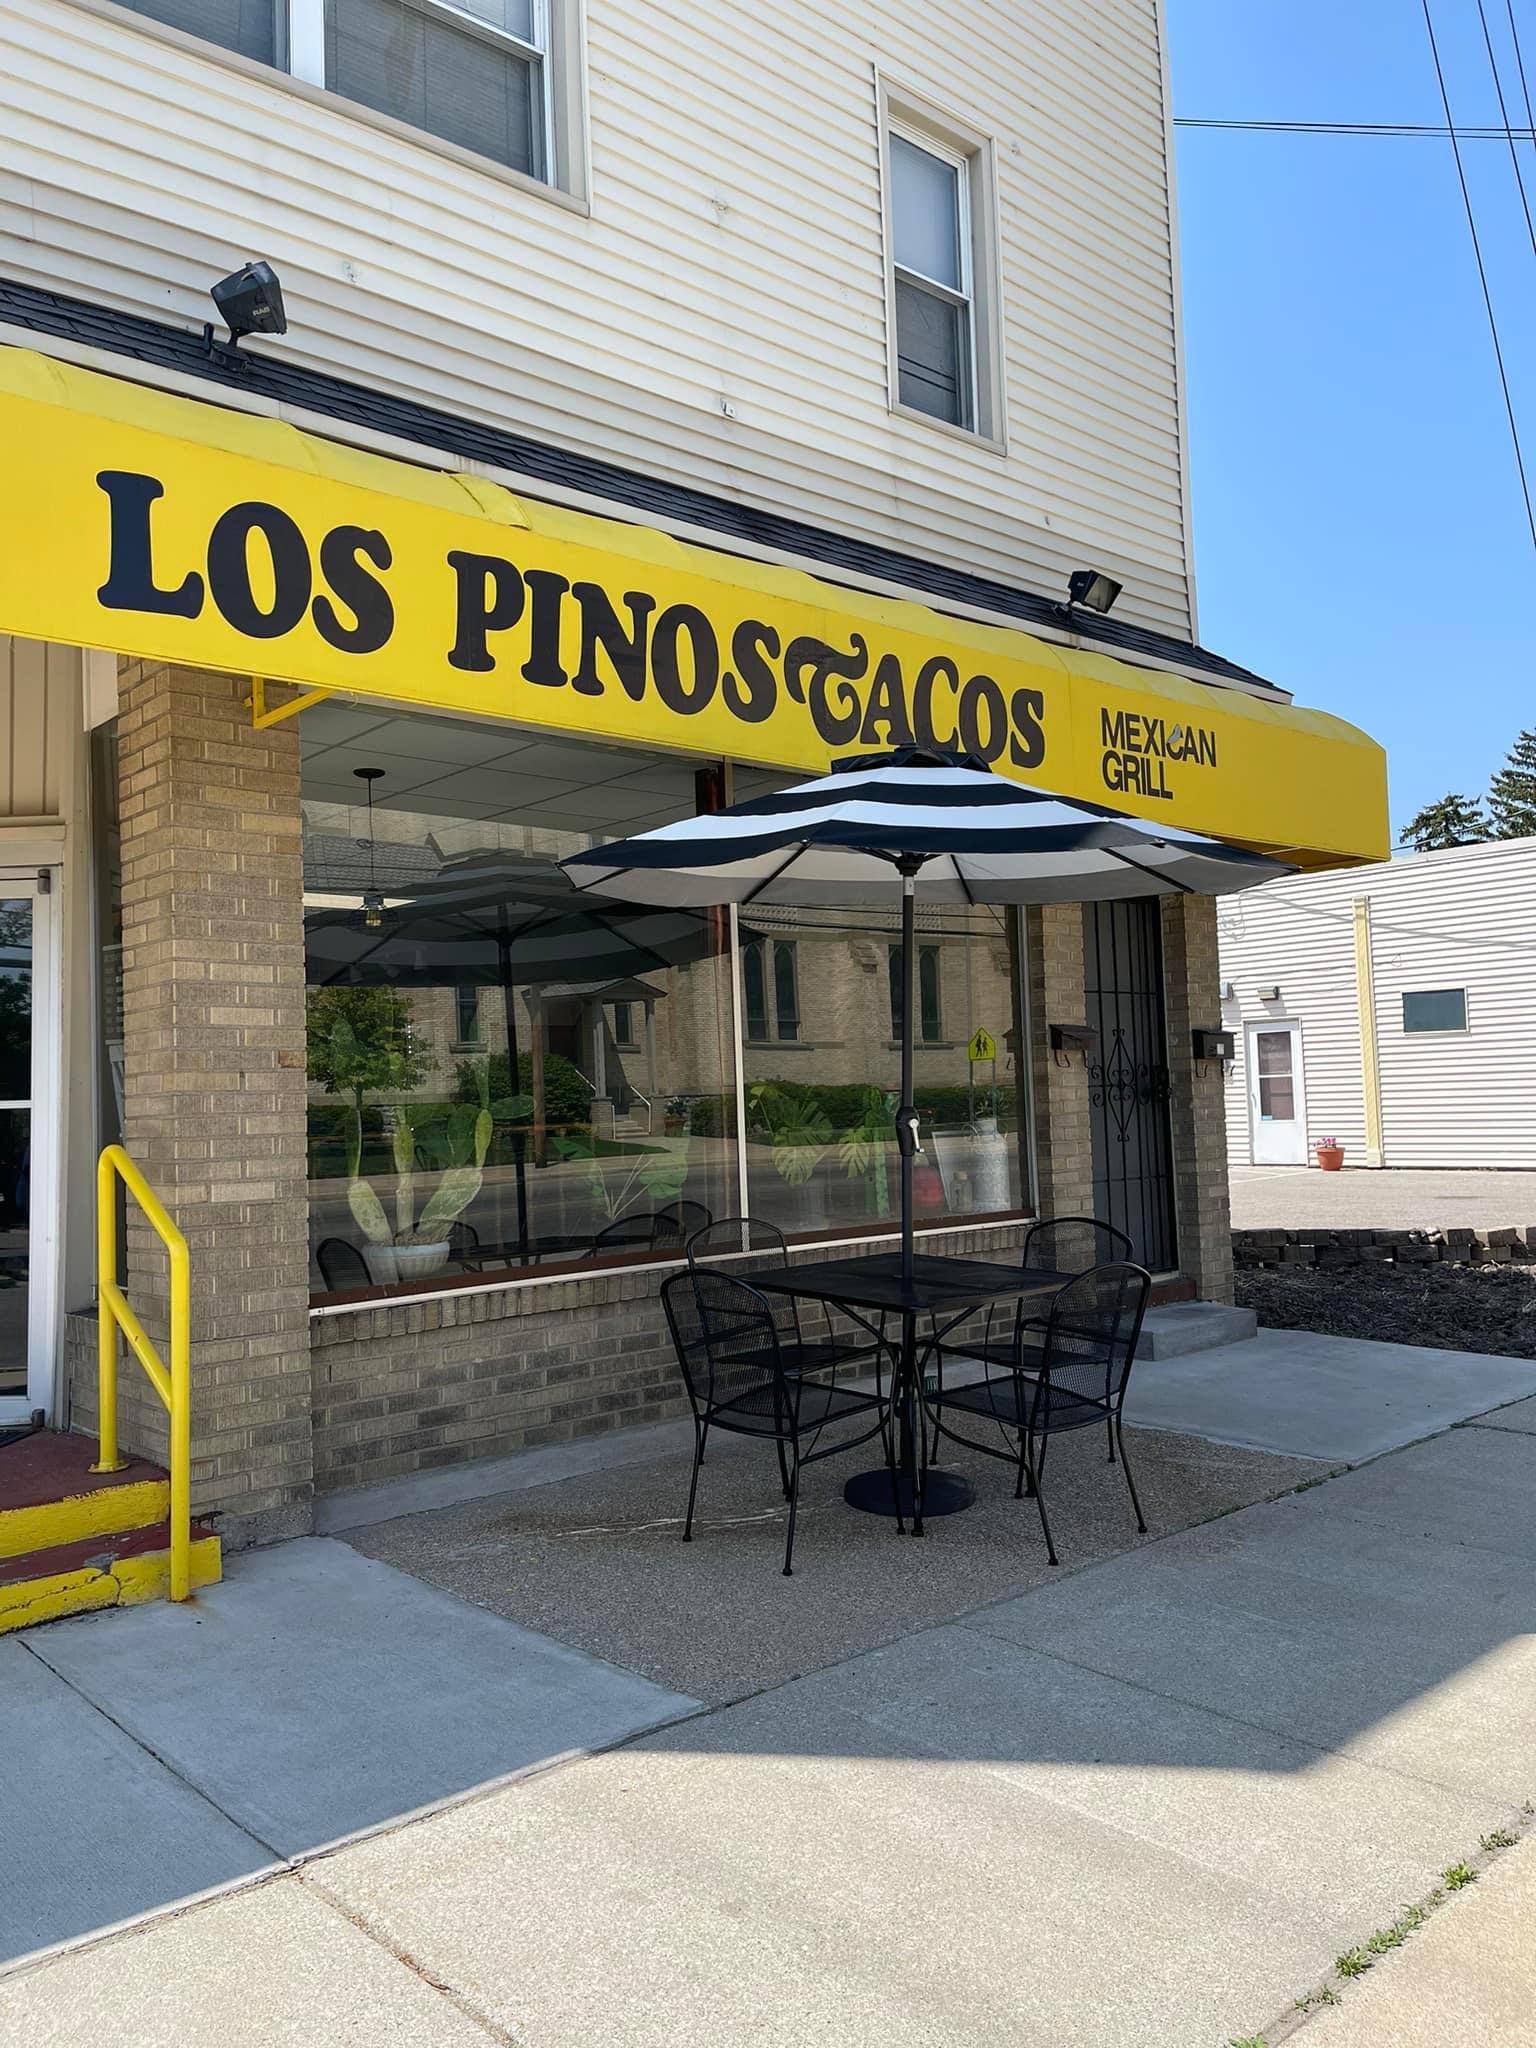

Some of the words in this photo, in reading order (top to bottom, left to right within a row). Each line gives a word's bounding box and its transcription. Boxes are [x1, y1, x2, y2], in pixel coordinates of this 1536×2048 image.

[96, 470, 395, 654] LOS
[447, 550, 780, 723] PINOS
[784, 632, 1046, 769] TACOS
[1101, 708, 1217, 768] MEXICAN
[1102, 750, 1174, 800] GRILL
